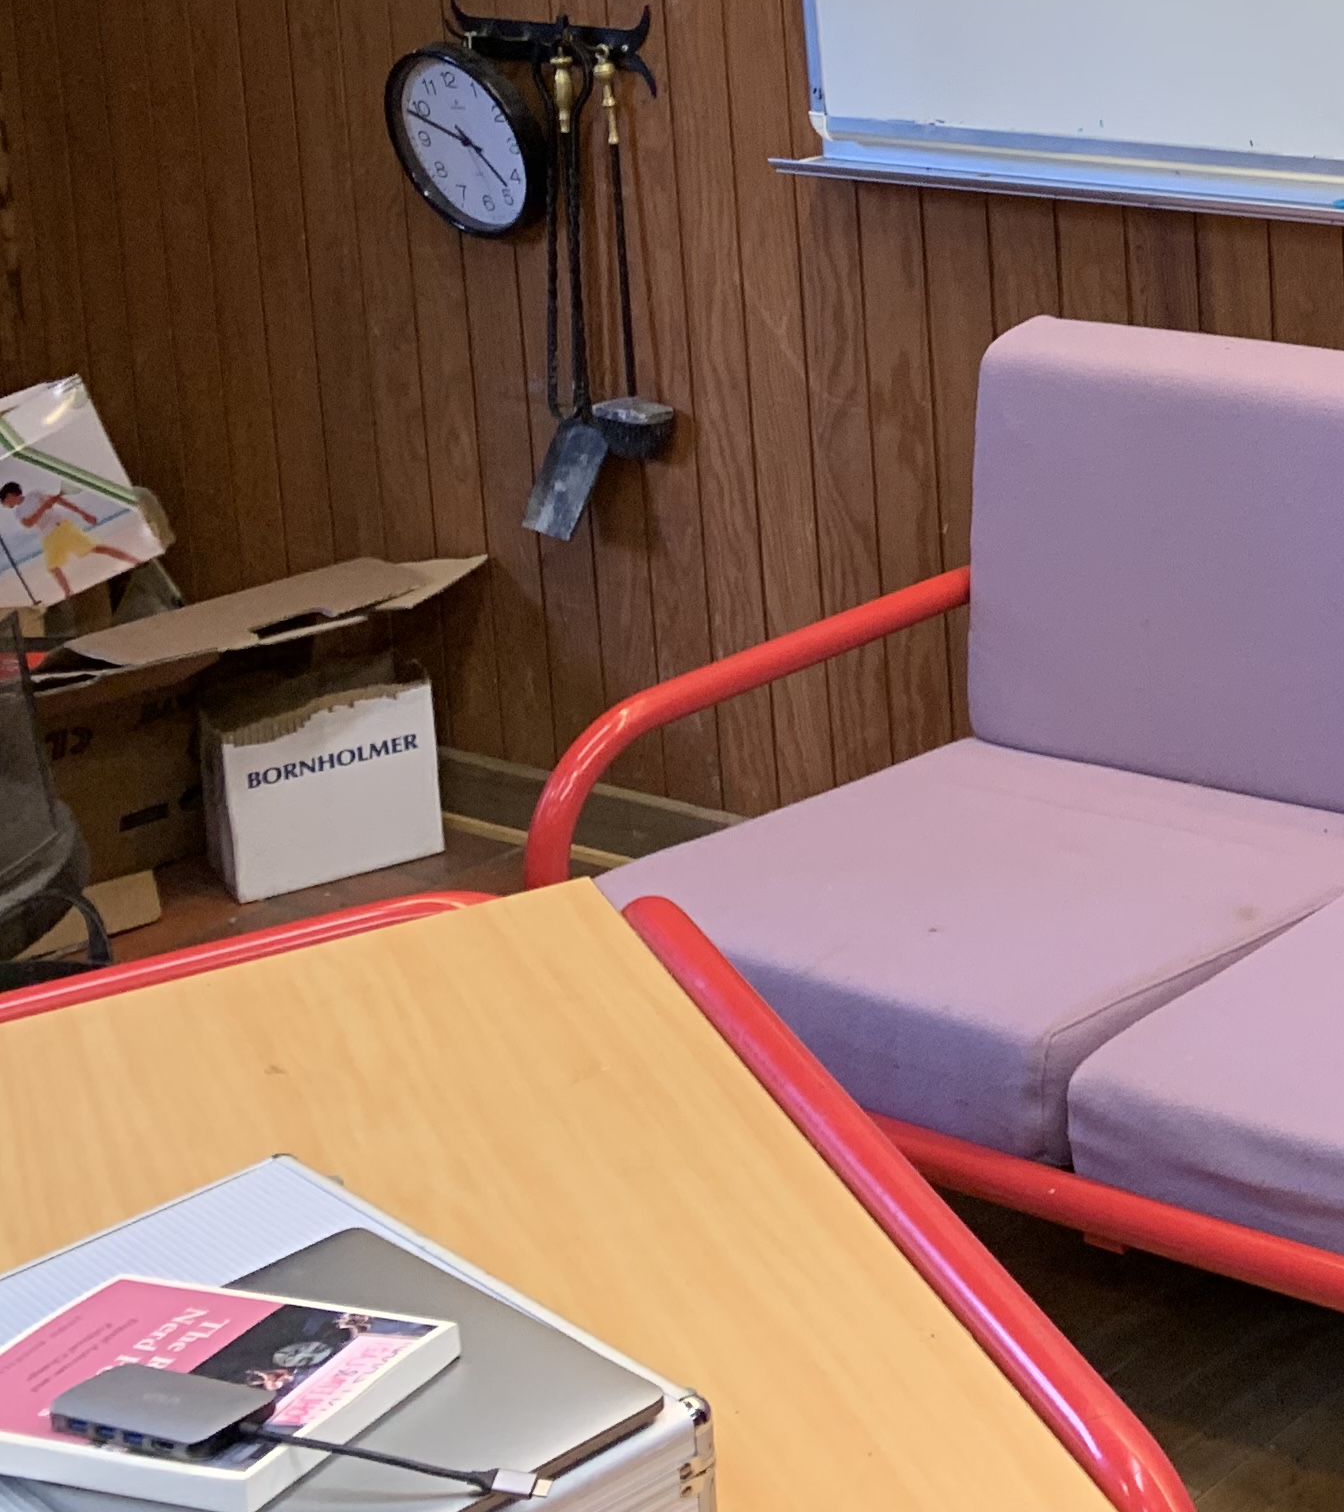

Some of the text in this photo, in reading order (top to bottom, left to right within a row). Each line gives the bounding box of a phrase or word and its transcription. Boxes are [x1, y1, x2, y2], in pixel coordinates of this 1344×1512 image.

[421, 78, 437, 96] 11
[440, 71, 456, 89] 12
[469, 81, 478, 99] 1
[411, 99, 430, 118] 10
[417, 130, 431, 148] 9
[433, 160, 448, 179] 8
[509, 167, 521, 185] 4
[455, 184, 467, 202] 7
[481, 193, 495, 212] 6
[246, 732, 420, 790] BORNHOLMER
[132, 1306, 210, 1353] Nerd
[166, 1318, 231, 1353] The
